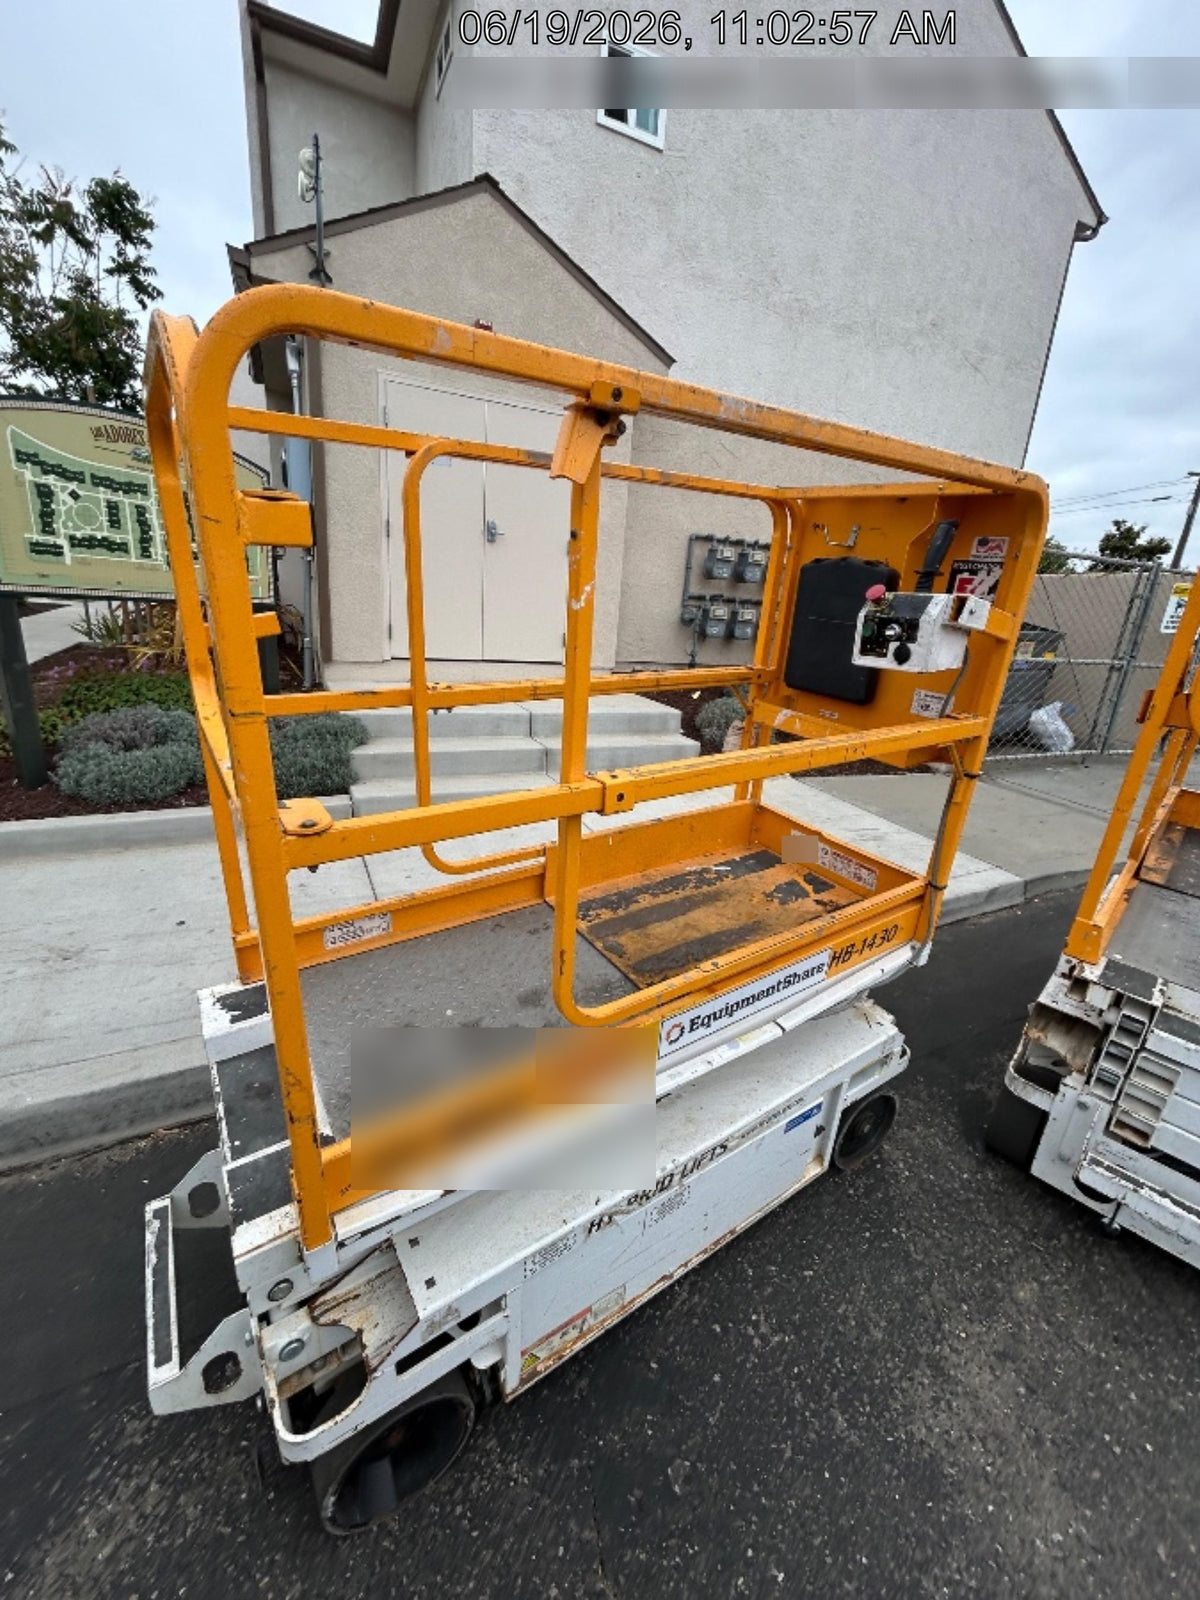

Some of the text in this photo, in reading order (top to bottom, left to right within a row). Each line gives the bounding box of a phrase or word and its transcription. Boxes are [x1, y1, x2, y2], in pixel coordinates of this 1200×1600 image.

[827, 923, 899, 970] HB-1430
[687, 962, 826, 1034] EquipmentShare
[680, 1142, 729, 1179] LIFTS
